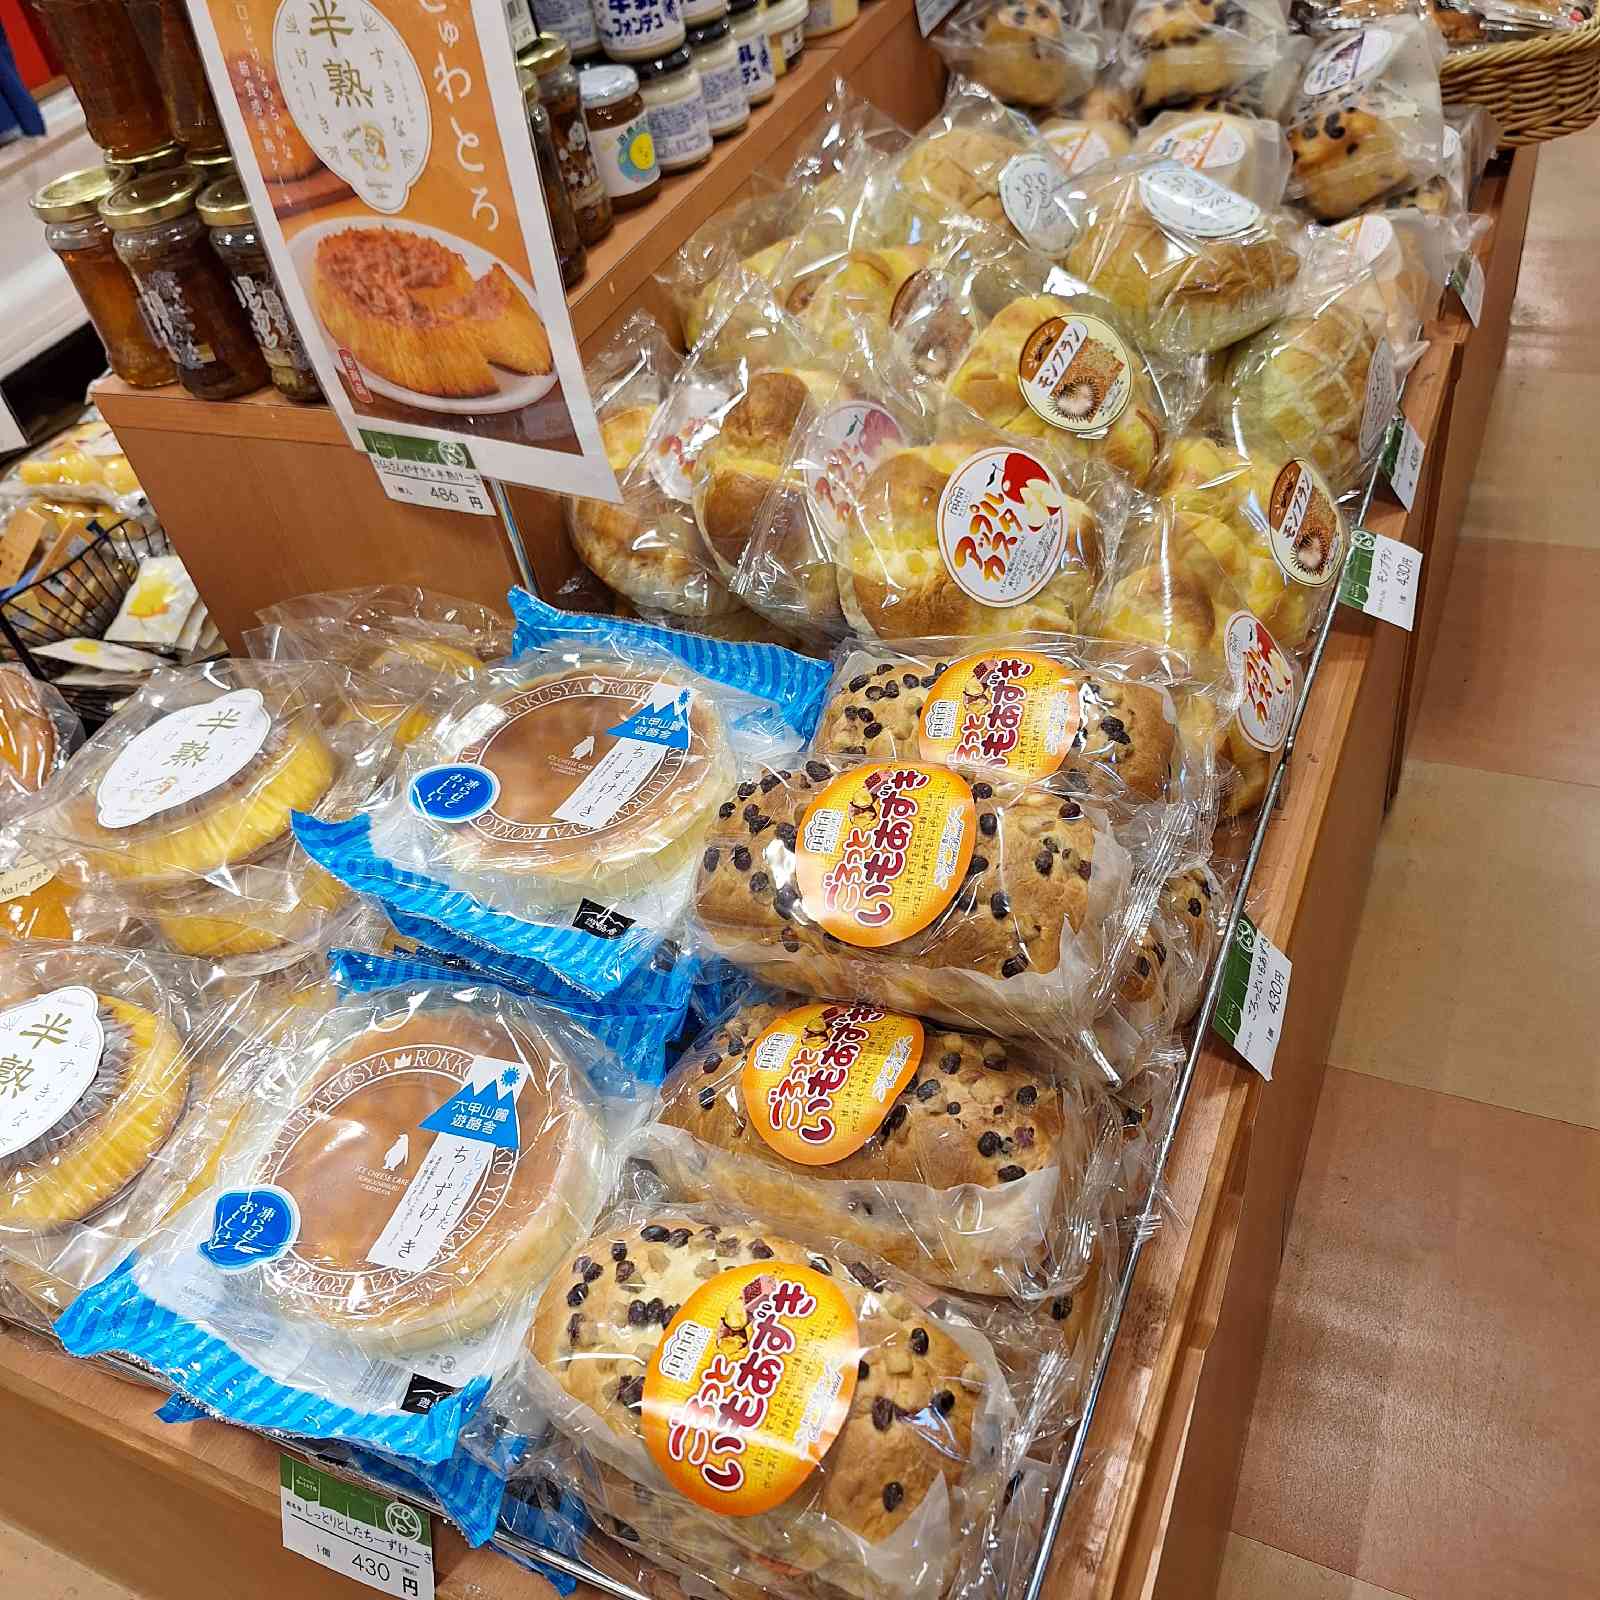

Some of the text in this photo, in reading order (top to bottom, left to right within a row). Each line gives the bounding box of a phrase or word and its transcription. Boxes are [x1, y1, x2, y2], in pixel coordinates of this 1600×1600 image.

[1037, 326, 1081, 389] モンブラン
[431, 486, 459, 504] 486
[469, 496, 485, 510] 円
[954, 491, 1005, 570] アップル
[983, 507, 1024, 582] カスタ
[161, 708, 241, 768] 半熟
[823, 828, 873, 911] ごろっと
[854, 768, 929, 926] いもあずき
[769, 1049, 819, 1129] ごろっと
[799, 1007, 887, 1144] いもあずき
[397, 1145, 472, 1259] ちーずけーき
[702, 1281, 817, 1492] いもあずき
[304, 1502, 432, 1565] しっとりとしたちーずけーき
[351, 1553, 391, 1582] 430
[402, 1576, 419, 1598] 円
